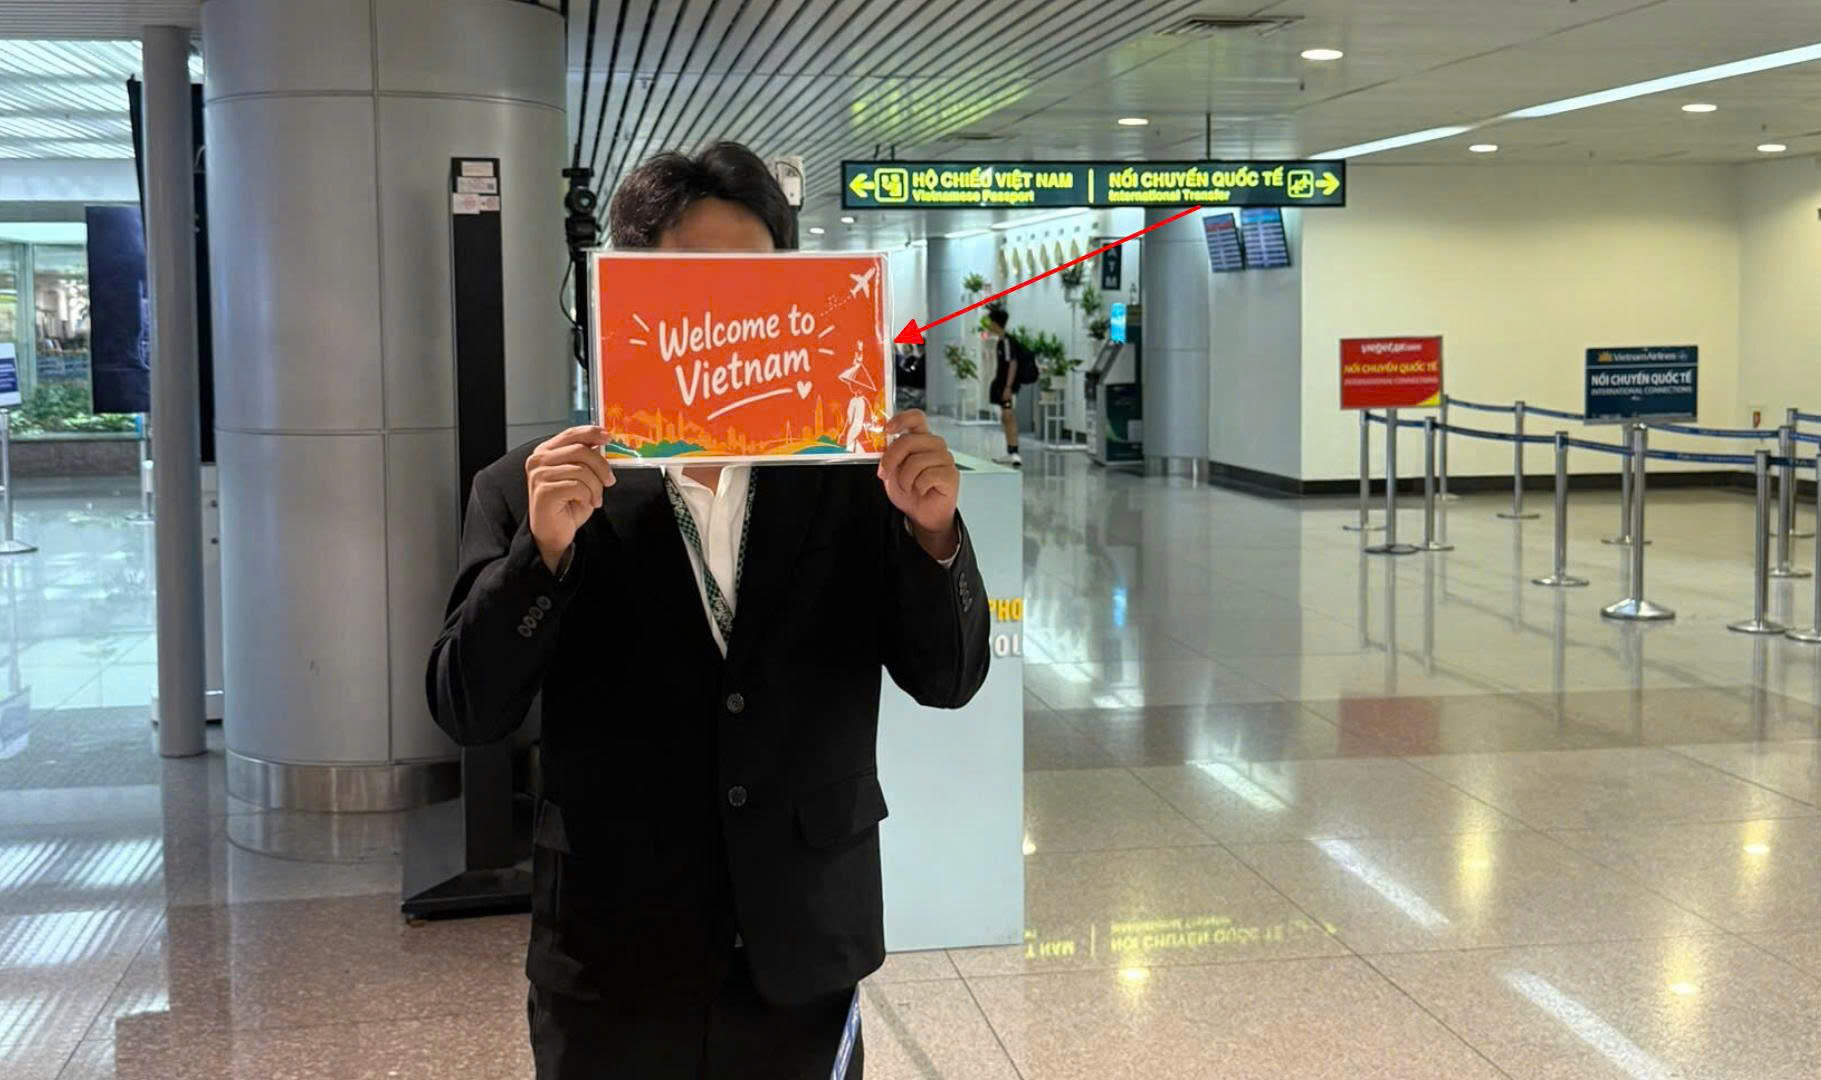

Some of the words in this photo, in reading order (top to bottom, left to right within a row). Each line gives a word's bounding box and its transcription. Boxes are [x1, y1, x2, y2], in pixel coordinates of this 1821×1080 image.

[912, 167, 939, 190] HỘ
[995, 168, 1034, 191] VIỆT
[1036, 172, 1073, 188] NAM
[1109, 167, 1138, 188] NỐI
[1211, 166, 1260, 187] QUỐC
[1261, 166, 1284, 186] TẾ
[658, 312, 780, 362] Welcome
[788, 304, 815, 338] to
[675, 348, 810, 406] Vietnam
[1591, 372, 1609, 386] NỐI
[1651, 370, 1680, 385] QUỐC
[1680, 371, 1693, 383] TẾ
